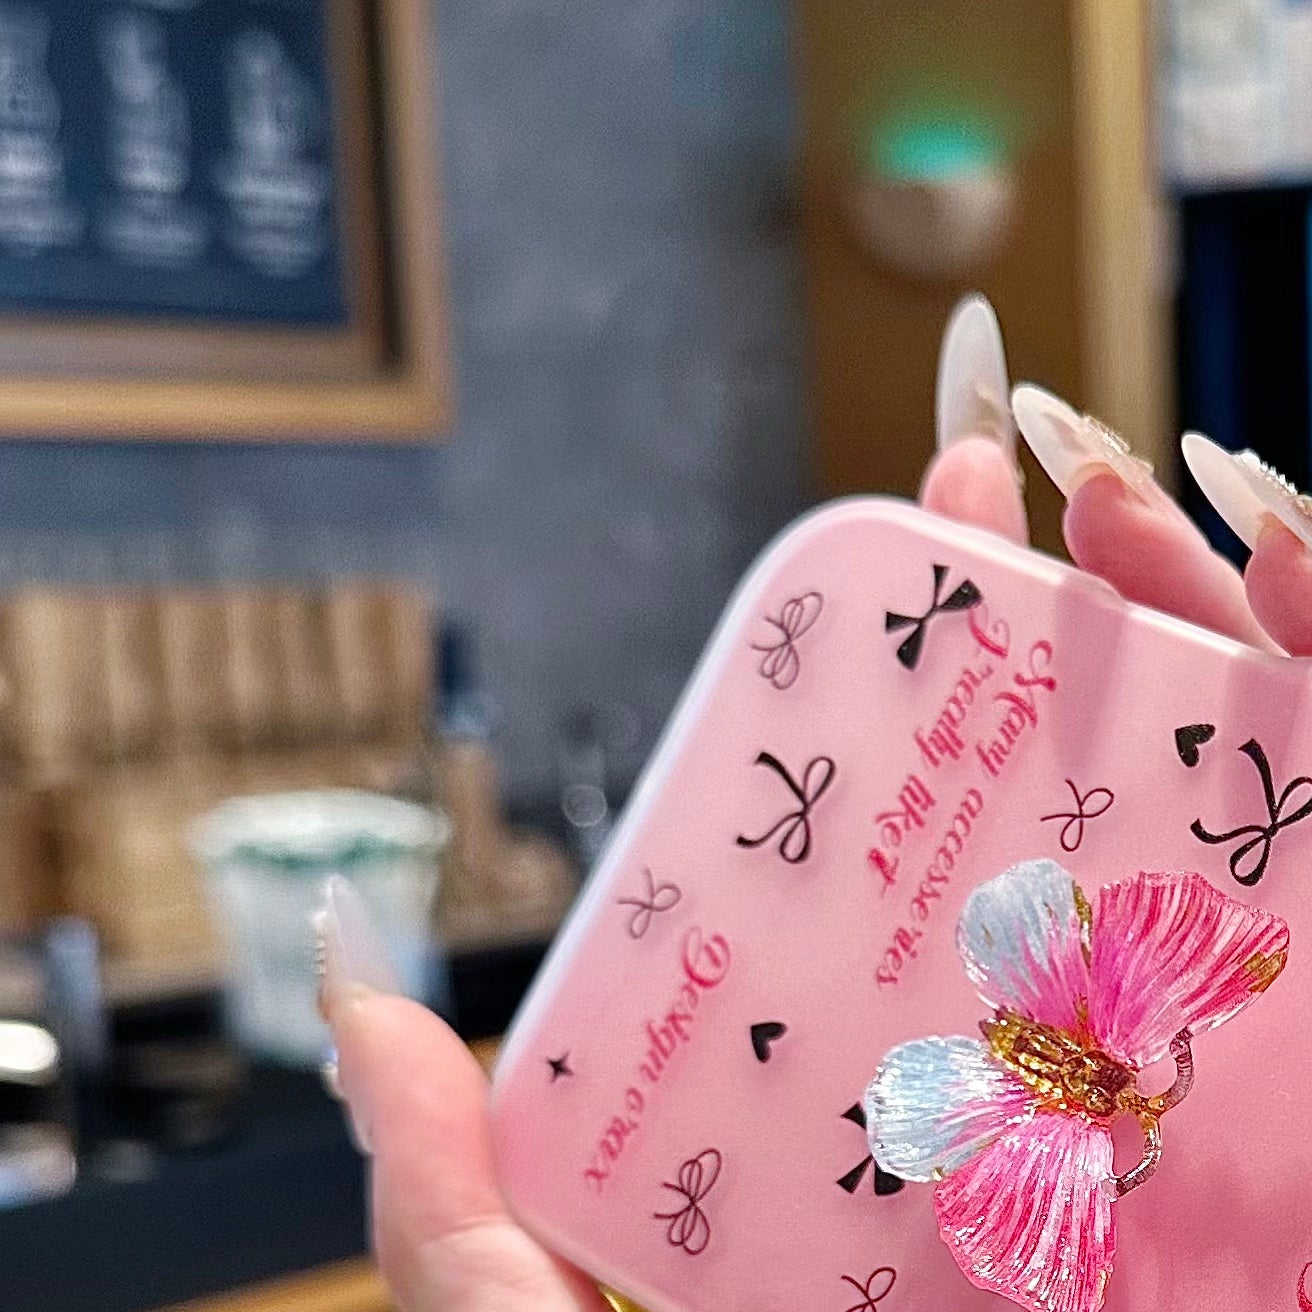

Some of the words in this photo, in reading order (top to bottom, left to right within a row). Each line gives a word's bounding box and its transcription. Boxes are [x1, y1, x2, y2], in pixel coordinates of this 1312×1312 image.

[914, 664, 995, 768] really
[976, 639, 1057, 778] Many
[640, 925, 732, 1083] Design
